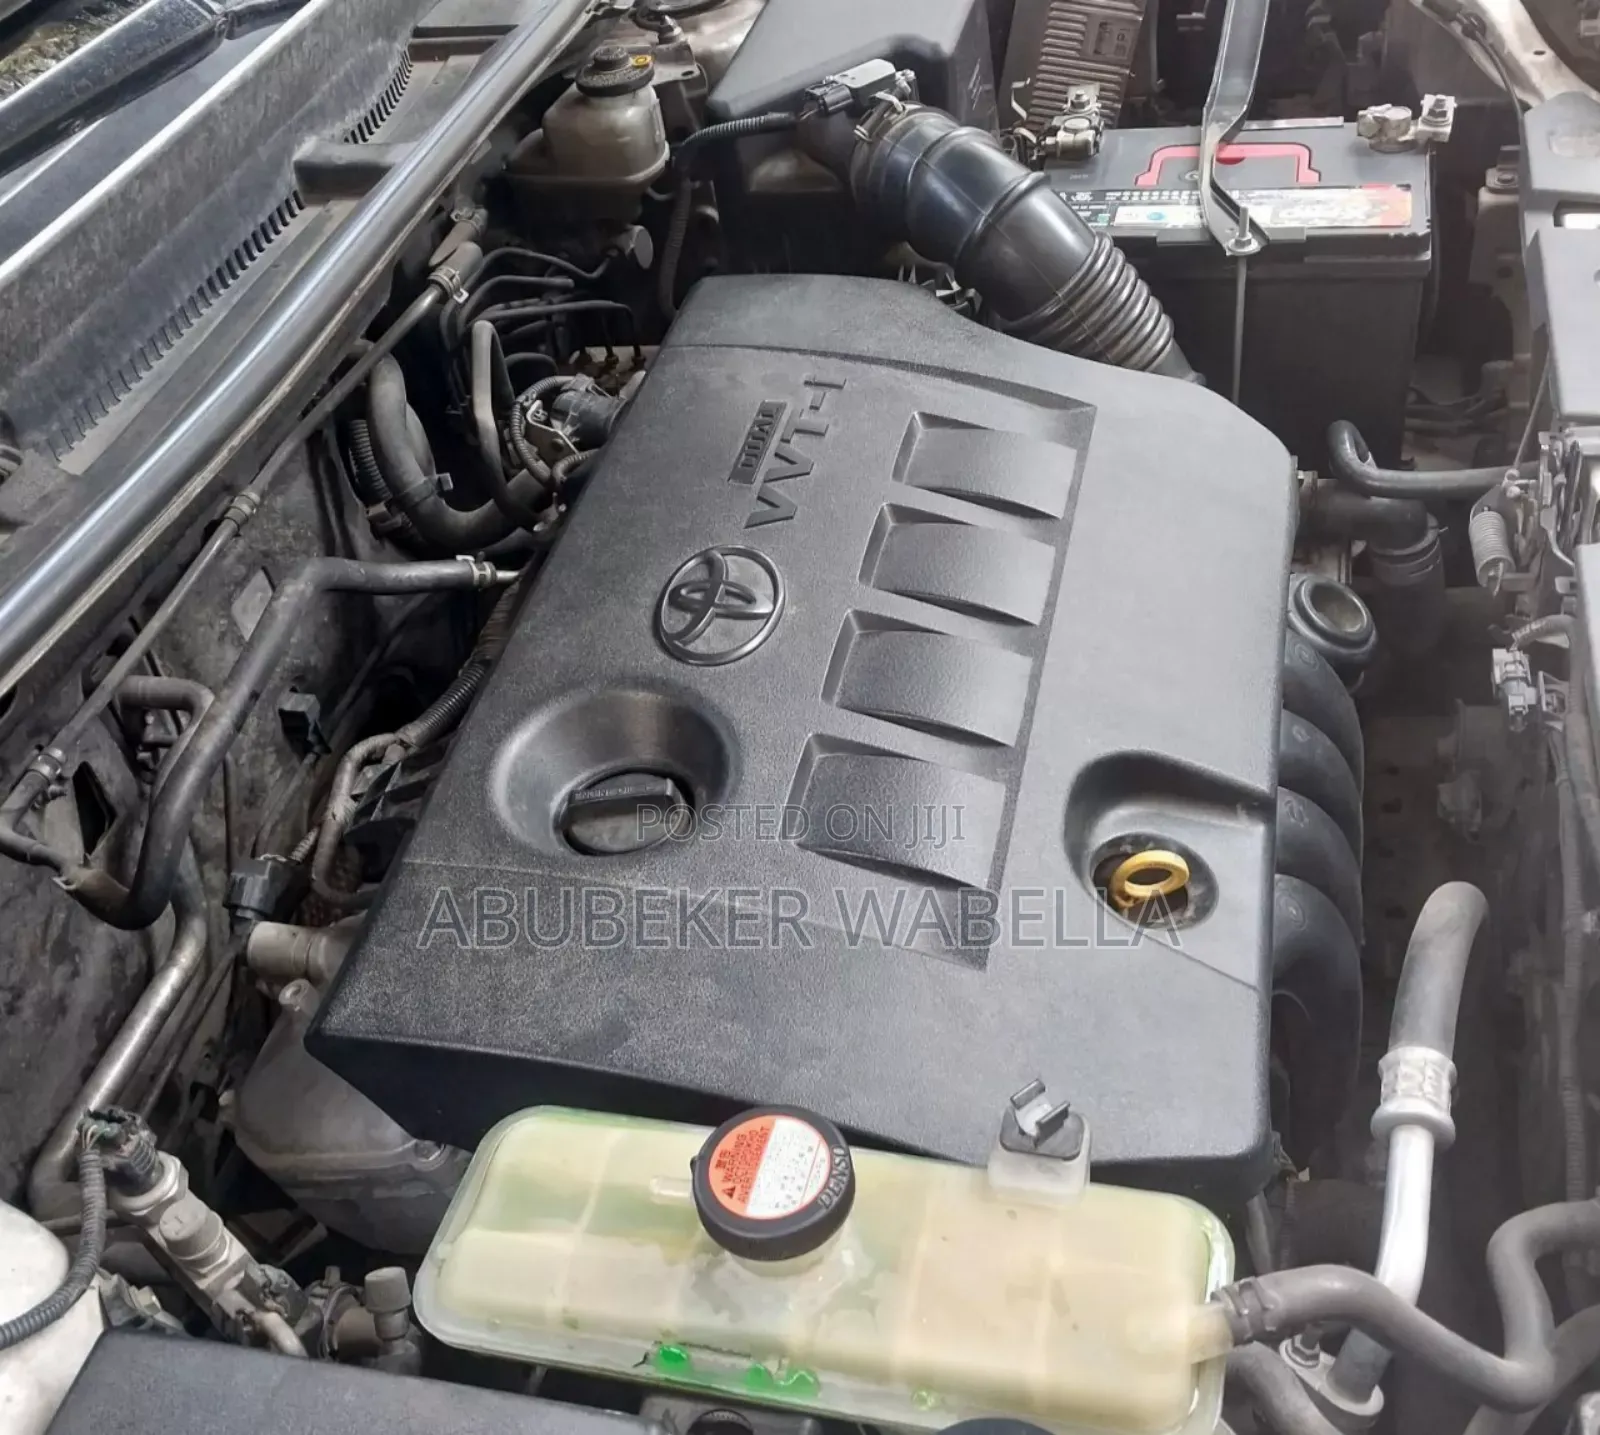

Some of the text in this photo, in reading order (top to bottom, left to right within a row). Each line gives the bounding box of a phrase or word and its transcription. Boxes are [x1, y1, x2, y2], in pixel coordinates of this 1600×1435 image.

[738, 407, 777, 469] DUAL
[723, 1134, 747, 1183] WARNING
[817, 1144, 849, 1210] DENSO
